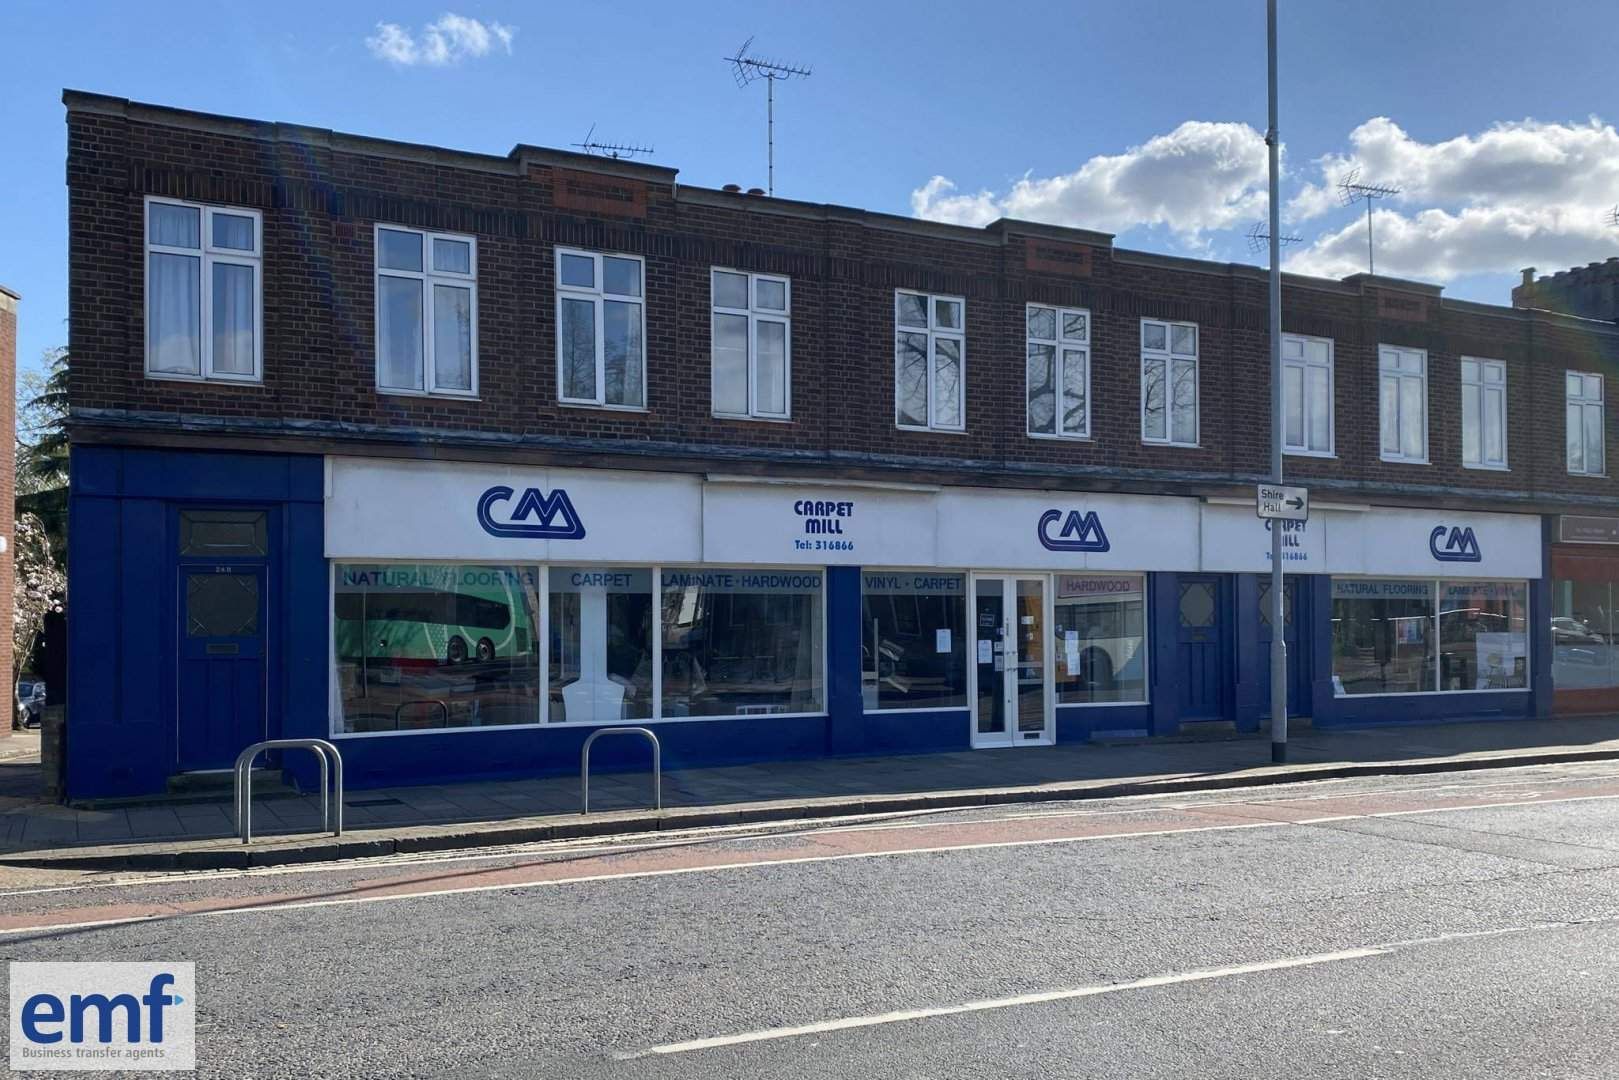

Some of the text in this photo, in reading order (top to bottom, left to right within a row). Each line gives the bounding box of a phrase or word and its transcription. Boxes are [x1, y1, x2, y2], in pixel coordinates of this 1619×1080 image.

[1261, 488, 1284, 500] Shire
[794, 500, 854, 516] CARPET
[1264, 501, 1281, 512] Hall
[805, 518, 843, 534] MILL
[795, 540, 854, 551] Tel: 316866
[343, 571, 433, 586] NATURAL
[571, 573, 633, 587] CARPET
[661, 573, 822, 589] LAMINATE HARDWOOD
[865, 577, 962, 590] VINYL CARPET
[1066, 580, 1131, 592] HARDWOOD
[1337, 583, 1429, 595] NATURAL FLOORING
